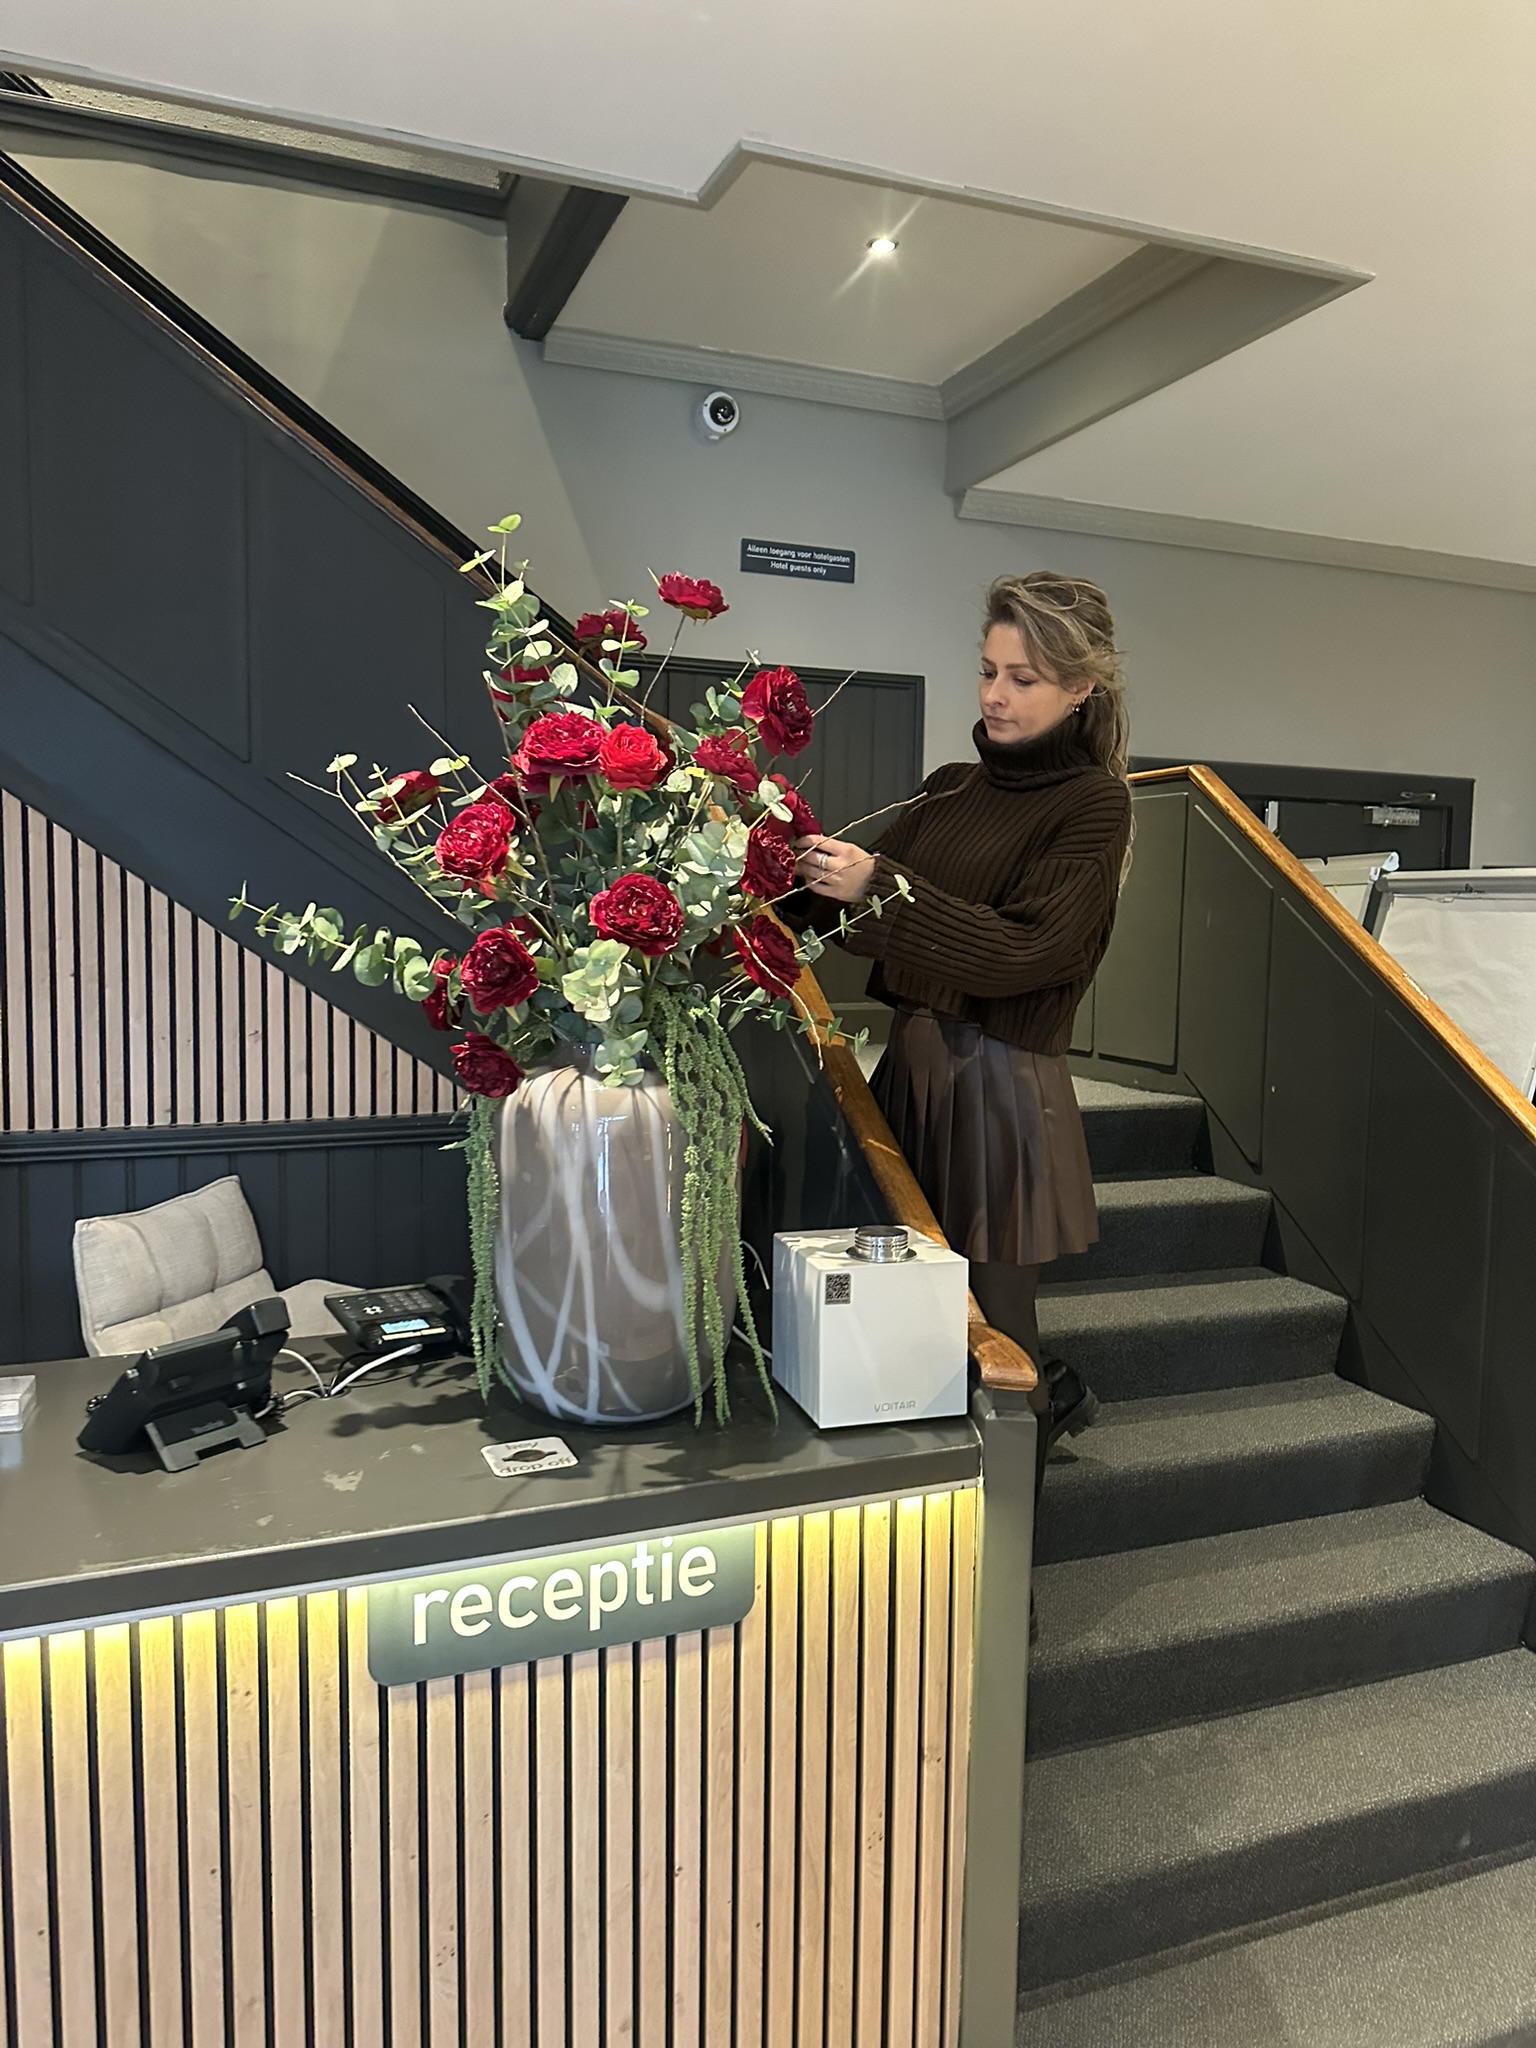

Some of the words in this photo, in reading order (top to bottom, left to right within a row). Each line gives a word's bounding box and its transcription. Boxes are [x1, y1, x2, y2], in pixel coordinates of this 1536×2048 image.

[747, 544, 768, 553] Alleen
[770, 547, 795, 558] toegang
[813, 552, 850, 562] hotelgasten
[771, 561, 788, 569] Hotel
[790, 564, 811, 572] guests
[813, 566, 826, 575] only
[874, 1400, 916, 1412] VOITAIR
[500, 1462, 543, 1475] drop
[548, 1457, 573, 1467] off
[413, 1536, 717, 1646] receptie
